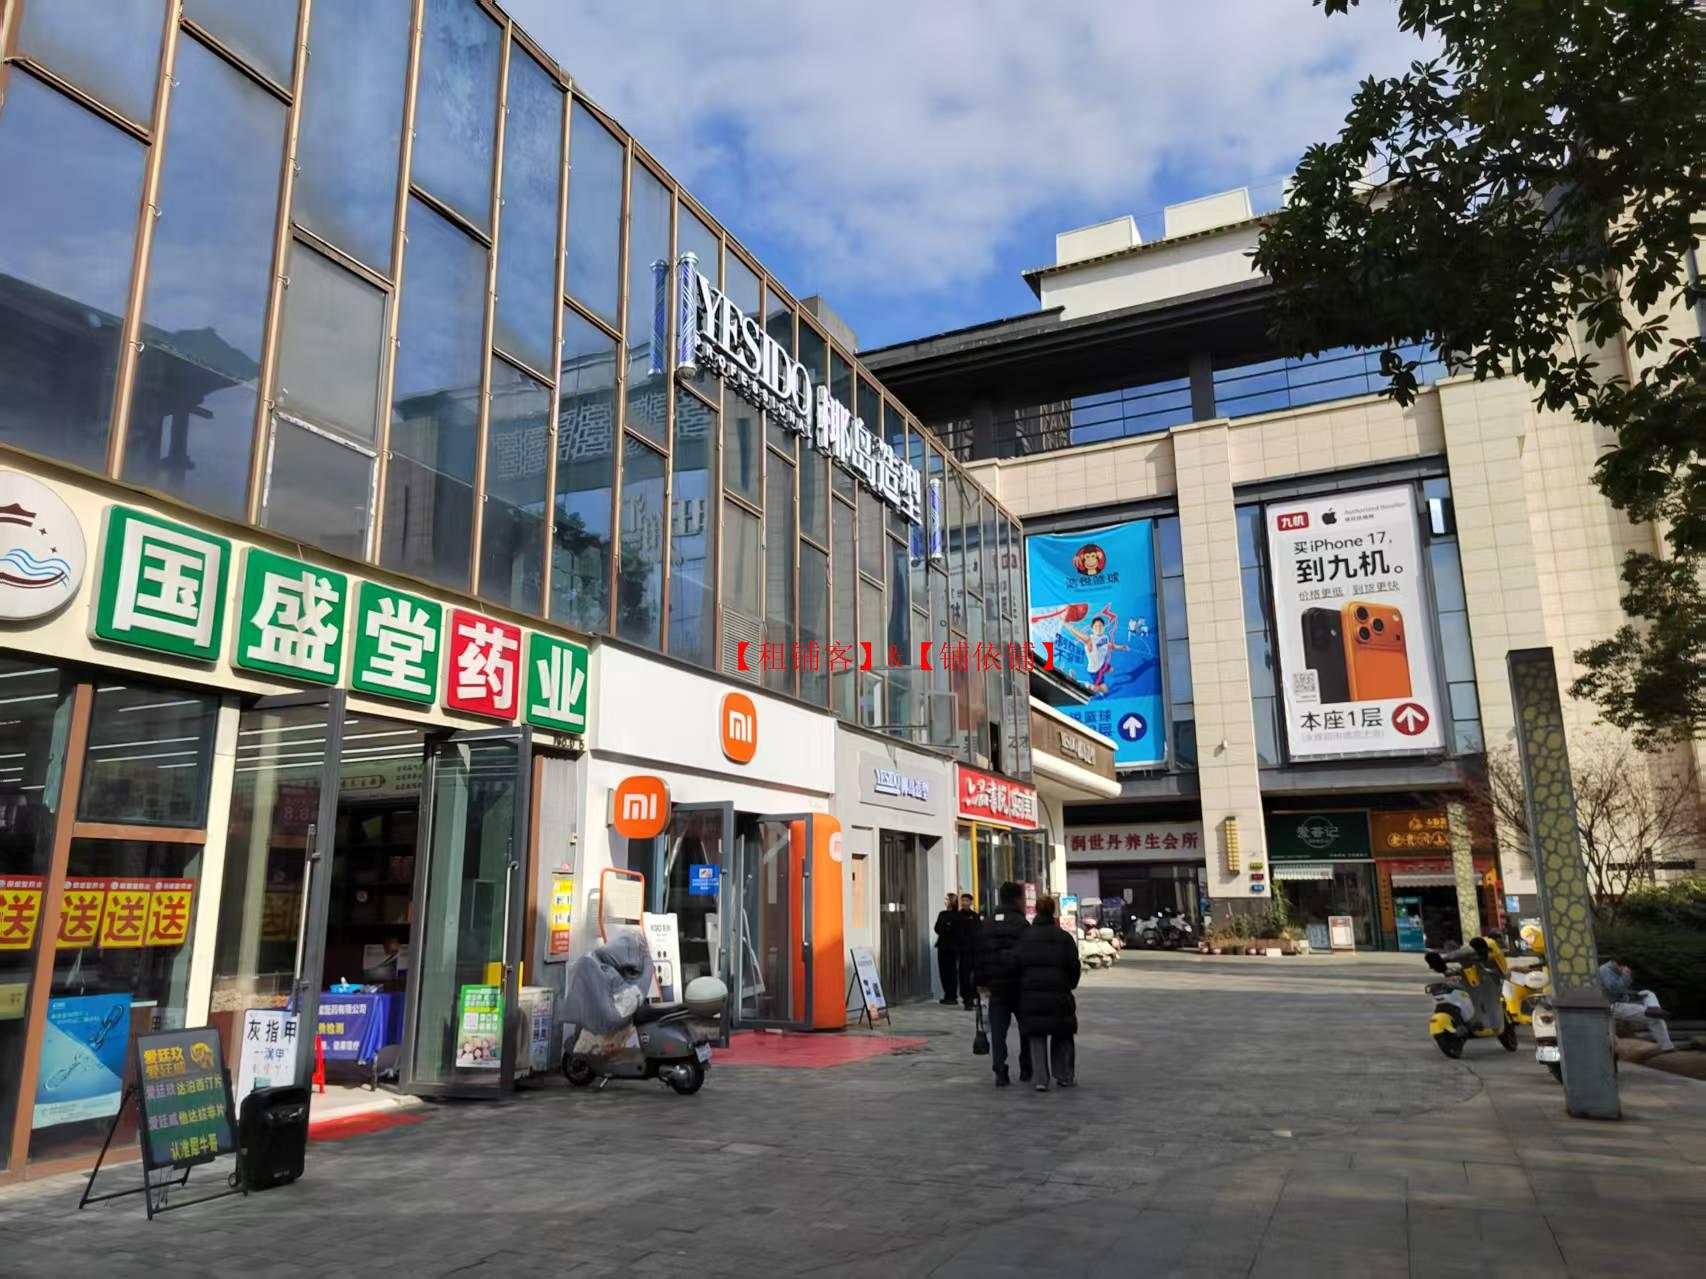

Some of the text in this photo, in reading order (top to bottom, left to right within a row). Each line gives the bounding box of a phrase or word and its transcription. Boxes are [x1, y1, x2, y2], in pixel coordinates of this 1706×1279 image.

[695, 272, 812, 415] YESIDO
[694, 332, 812, 440] PROFESSIONAL
[1281, 514, 1305, 528] 九机
[1296, 550, 1404, 584] 到九机。
[1298, 587, 1345, 602] 价格更低
[112, 517, 585, 725] 国盛堂药业
[1300, 707, 1384, 732] 本座1层
[0, 895, 35, 944] 送
[57, 895, 99, 943] 送
[103, 896, 145, 942] 送
[150, 895, 187, 940] 送
[247, 1018, 298, 1044] 灰指甲
